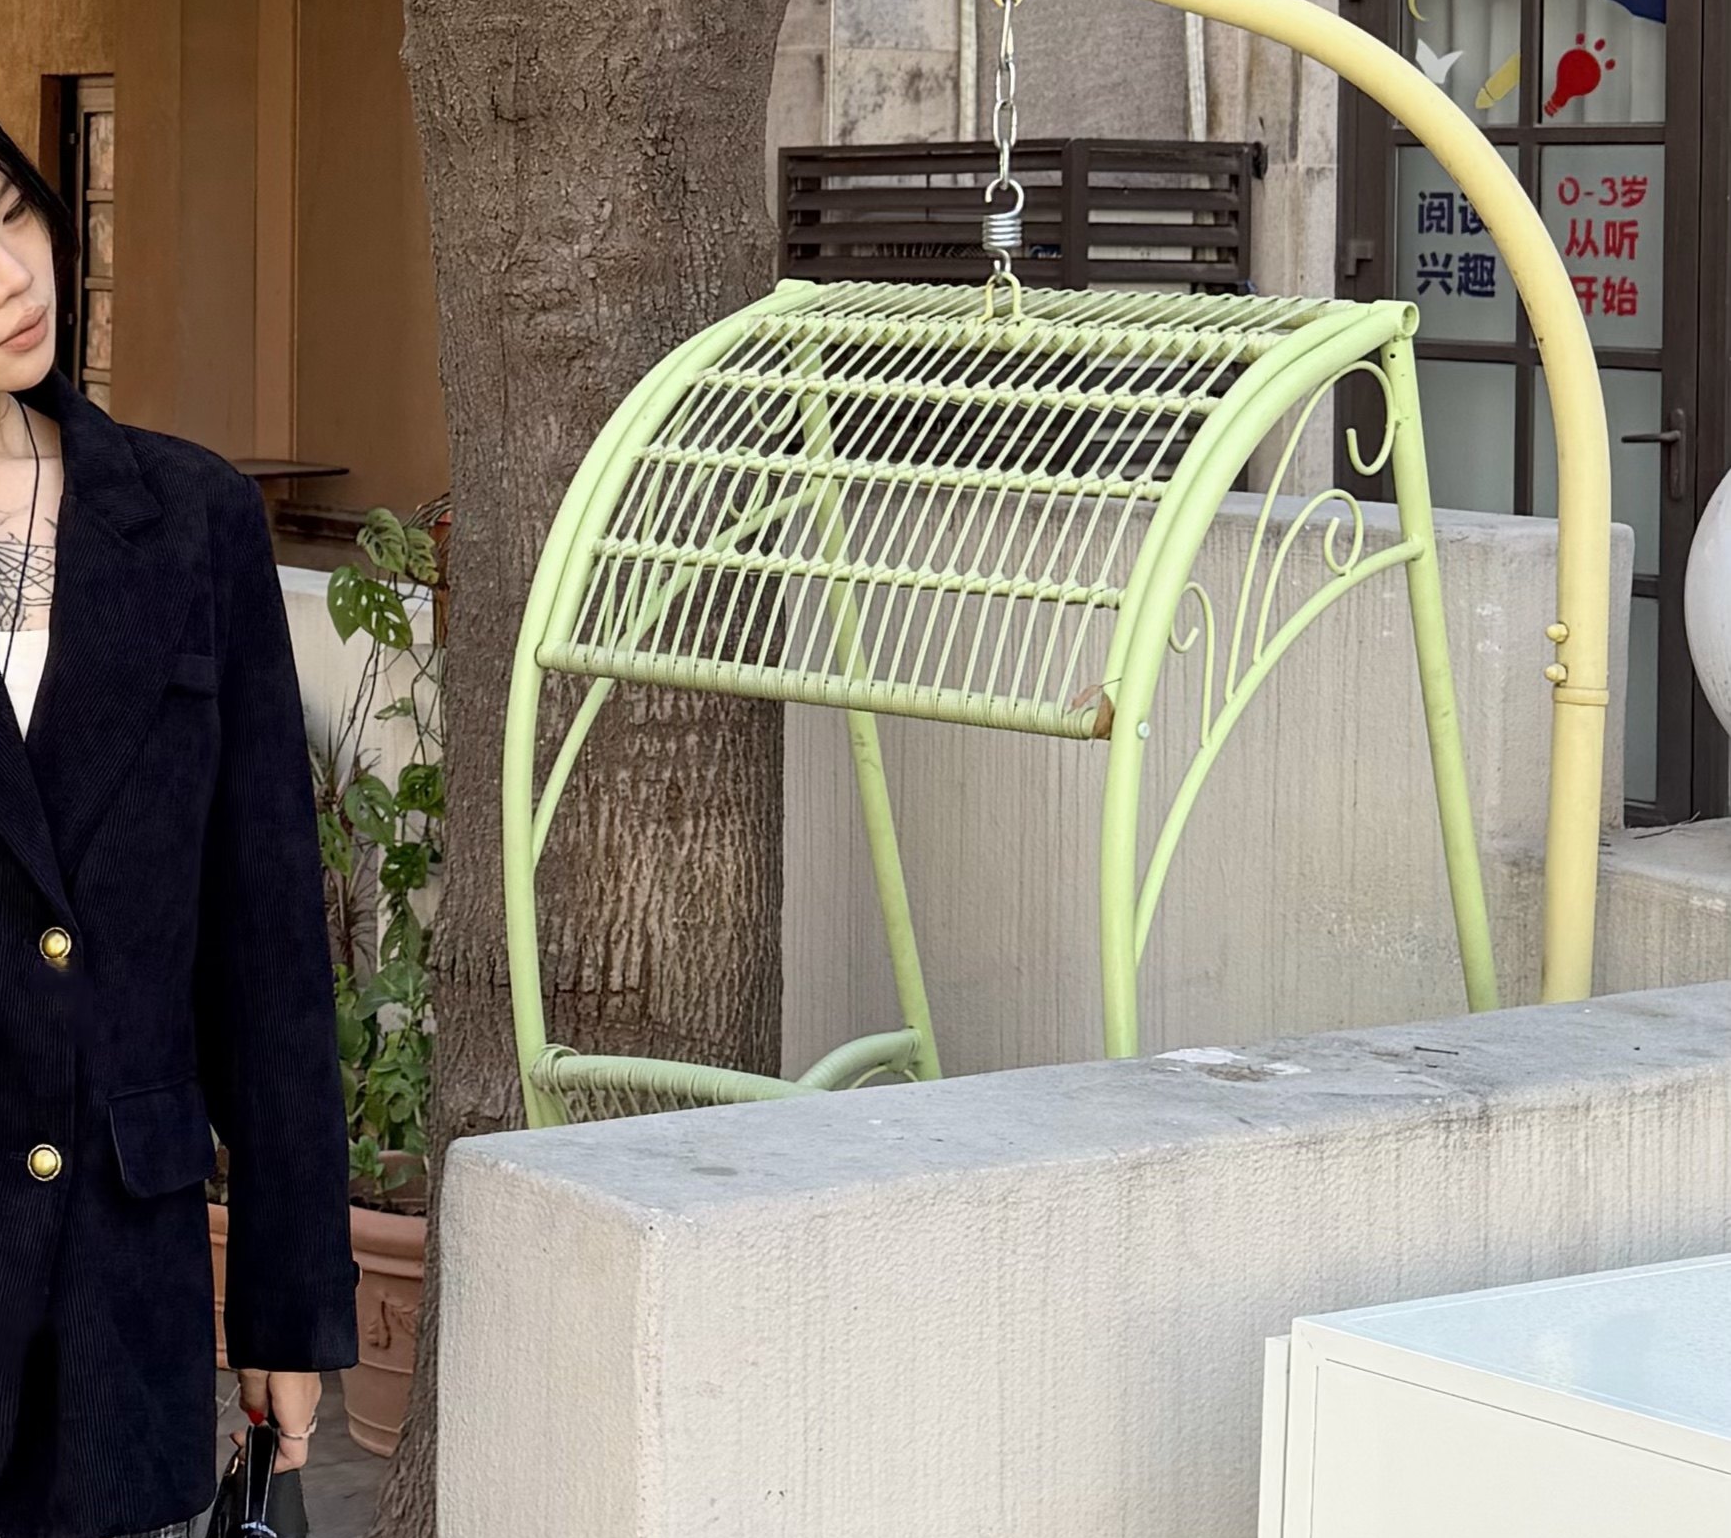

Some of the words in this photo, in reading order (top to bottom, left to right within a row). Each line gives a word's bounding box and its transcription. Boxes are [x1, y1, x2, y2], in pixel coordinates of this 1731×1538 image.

[1558, 175, 1648, 209] 0-3岁
[1565, 218, 1639, 260] 从听
[1417, 251, 1496, 298] 兴趣
[1569, 275, 1638, 317] 开始
